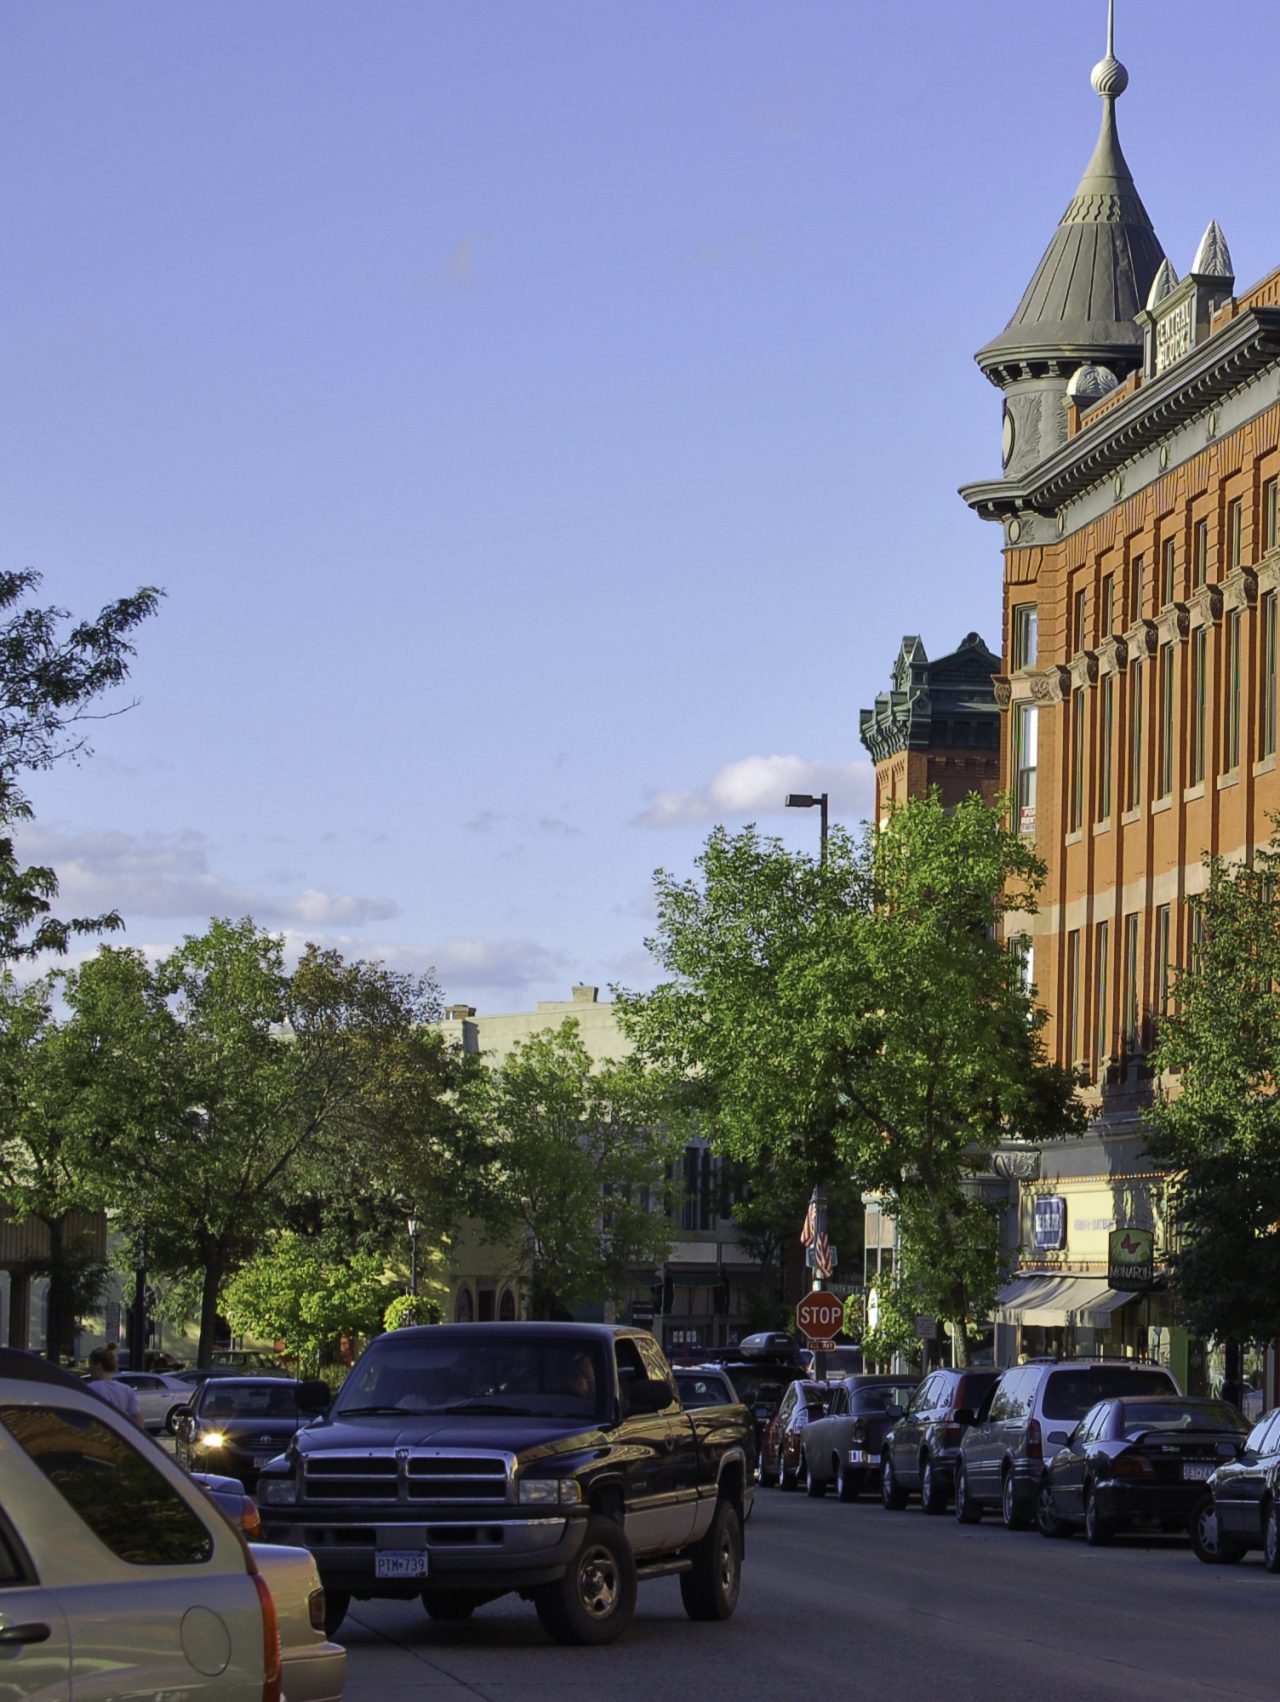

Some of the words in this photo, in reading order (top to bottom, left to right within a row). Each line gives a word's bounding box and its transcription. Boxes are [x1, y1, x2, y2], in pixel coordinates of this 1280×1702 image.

[1156, 299, 1191, 346] CENTRAL
[1156, 328, 1188, 370] BLOCK
[1110, 1264, 1151, 1279] MONARCH
[801, 1307, 842, 1325] STOP
